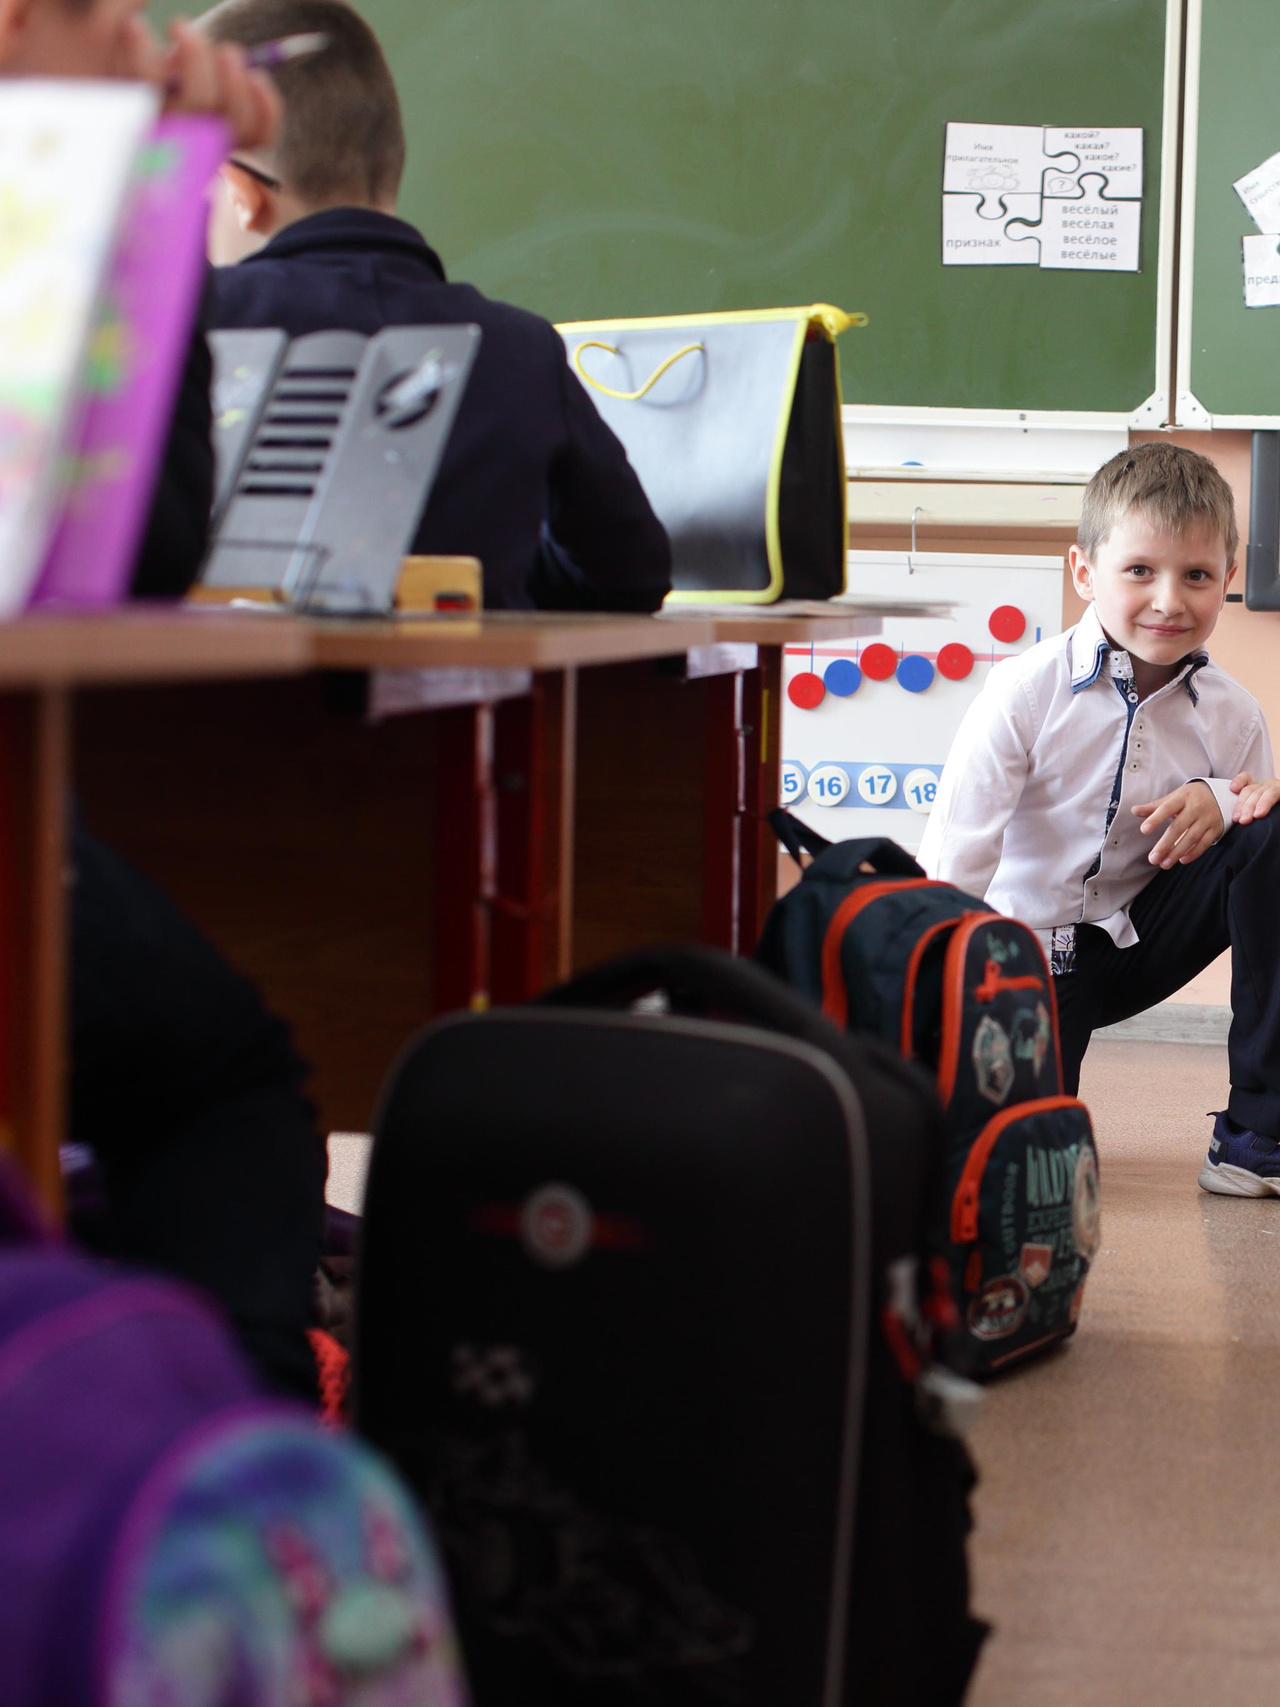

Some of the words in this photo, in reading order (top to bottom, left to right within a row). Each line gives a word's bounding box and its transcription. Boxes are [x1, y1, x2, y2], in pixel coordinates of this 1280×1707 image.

[1065, 130, 1100, 139] какой?
[1075, 141, 1110, 150] какая?
[1085, 152, 1120, 161] какое?
[1101, 163, 1137, 172] какие?
[1062, 204, 1119, 216] весёлый
[1062, 218, 1115, 230] весёлая
[946, 238, 1001, 250] признак
[1063, 233, 1118, 246] весёлое
[1061, 249, 1117, 261] весёлые
[780, 774, 798, 793] 5
[815, 776, 842, 796] 16
[865, 775, 892, 794] 17
[911, 782, 937, 804] 18
